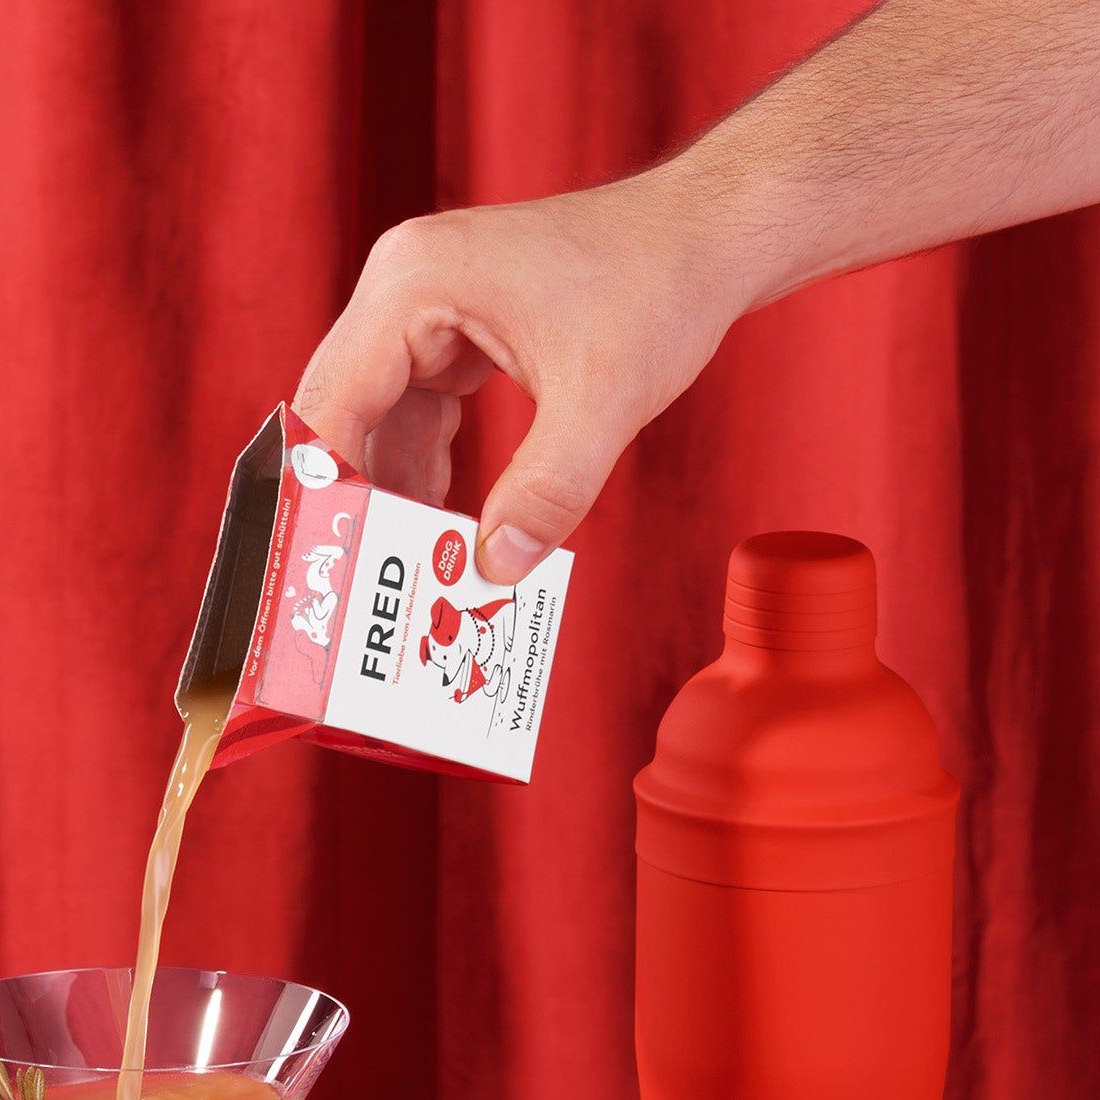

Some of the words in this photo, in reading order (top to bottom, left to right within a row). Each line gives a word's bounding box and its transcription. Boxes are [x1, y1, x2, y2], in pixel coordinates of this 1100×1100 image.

[437, 540, 453, 571] DOG
[443, 540, 462, 580] DRINK
[249, 659, 259, 677] Vor
[254, 636, 263, 657] dem
[259, 600, 272, 633] Öffnen
[267, 572, 277, 597] bitte
[273, 552, 282, 570] gut
[360, 556, 405, 681] FRED
[543, 596, 556, 645] Rosmarin
[392, 645, 405, 685] Tierliebe
[402, 623, 410, 641] vom
[509, 588, 547, 731] Wuffmopolitan
[540, 647, 548, 666] mit
[525, 669, 543, 731] Rinderbrühe
